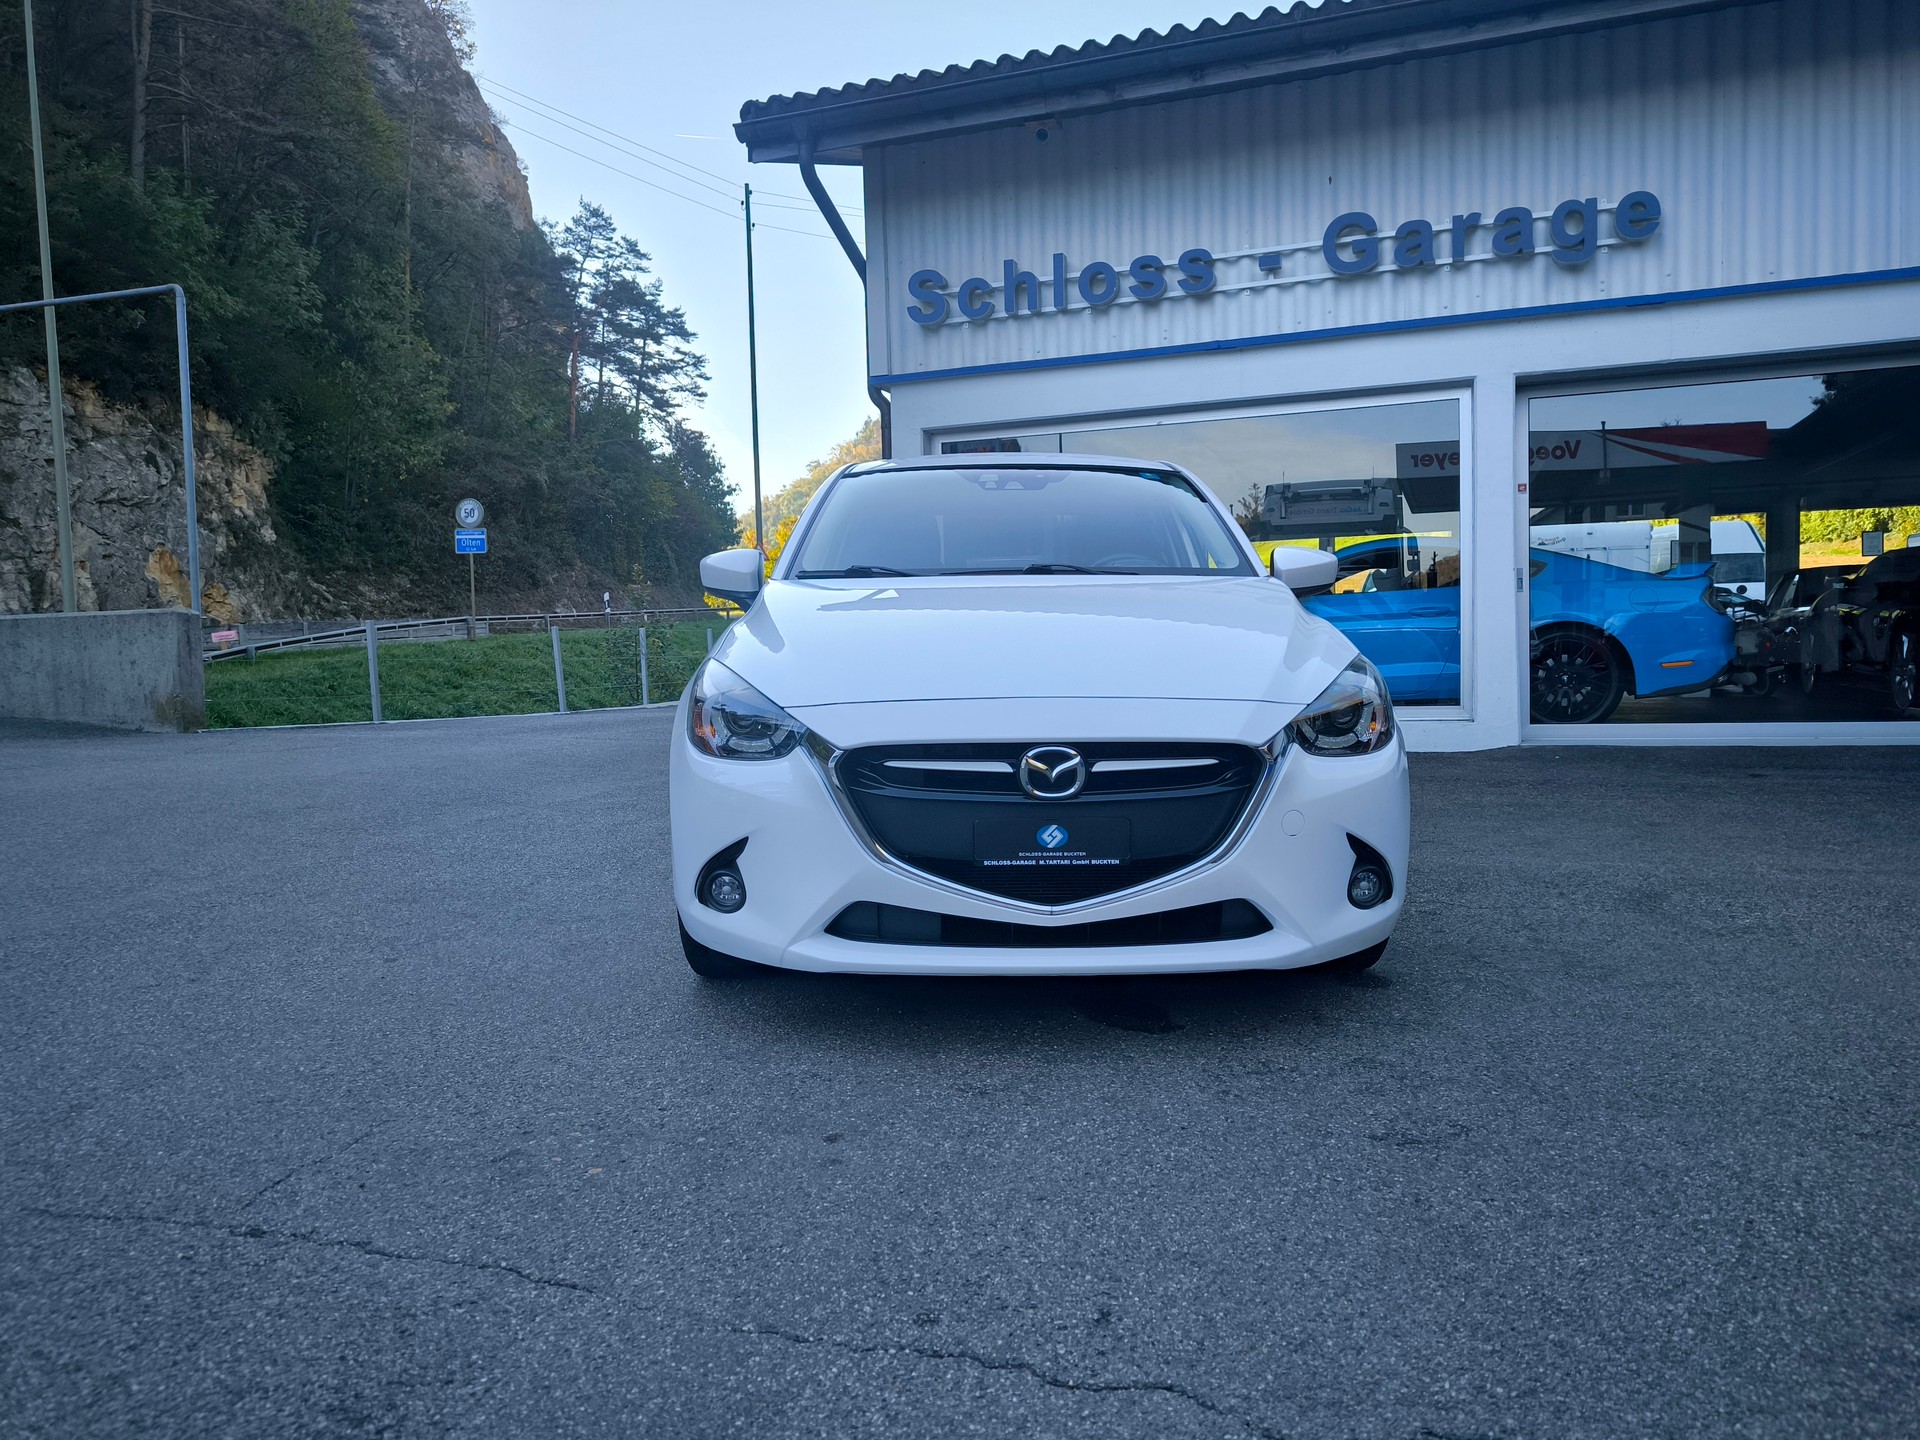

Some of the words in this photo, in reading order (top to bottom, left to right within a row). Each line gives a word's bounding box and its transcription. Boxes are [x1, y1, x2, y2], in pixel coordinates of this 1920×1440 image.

[907, 247, 1217, 326] Schloss
[1322, 190, 1662, 276] Garage
[464, 508, 475, 519] 50
[461, 538, 480, 546] Olten
